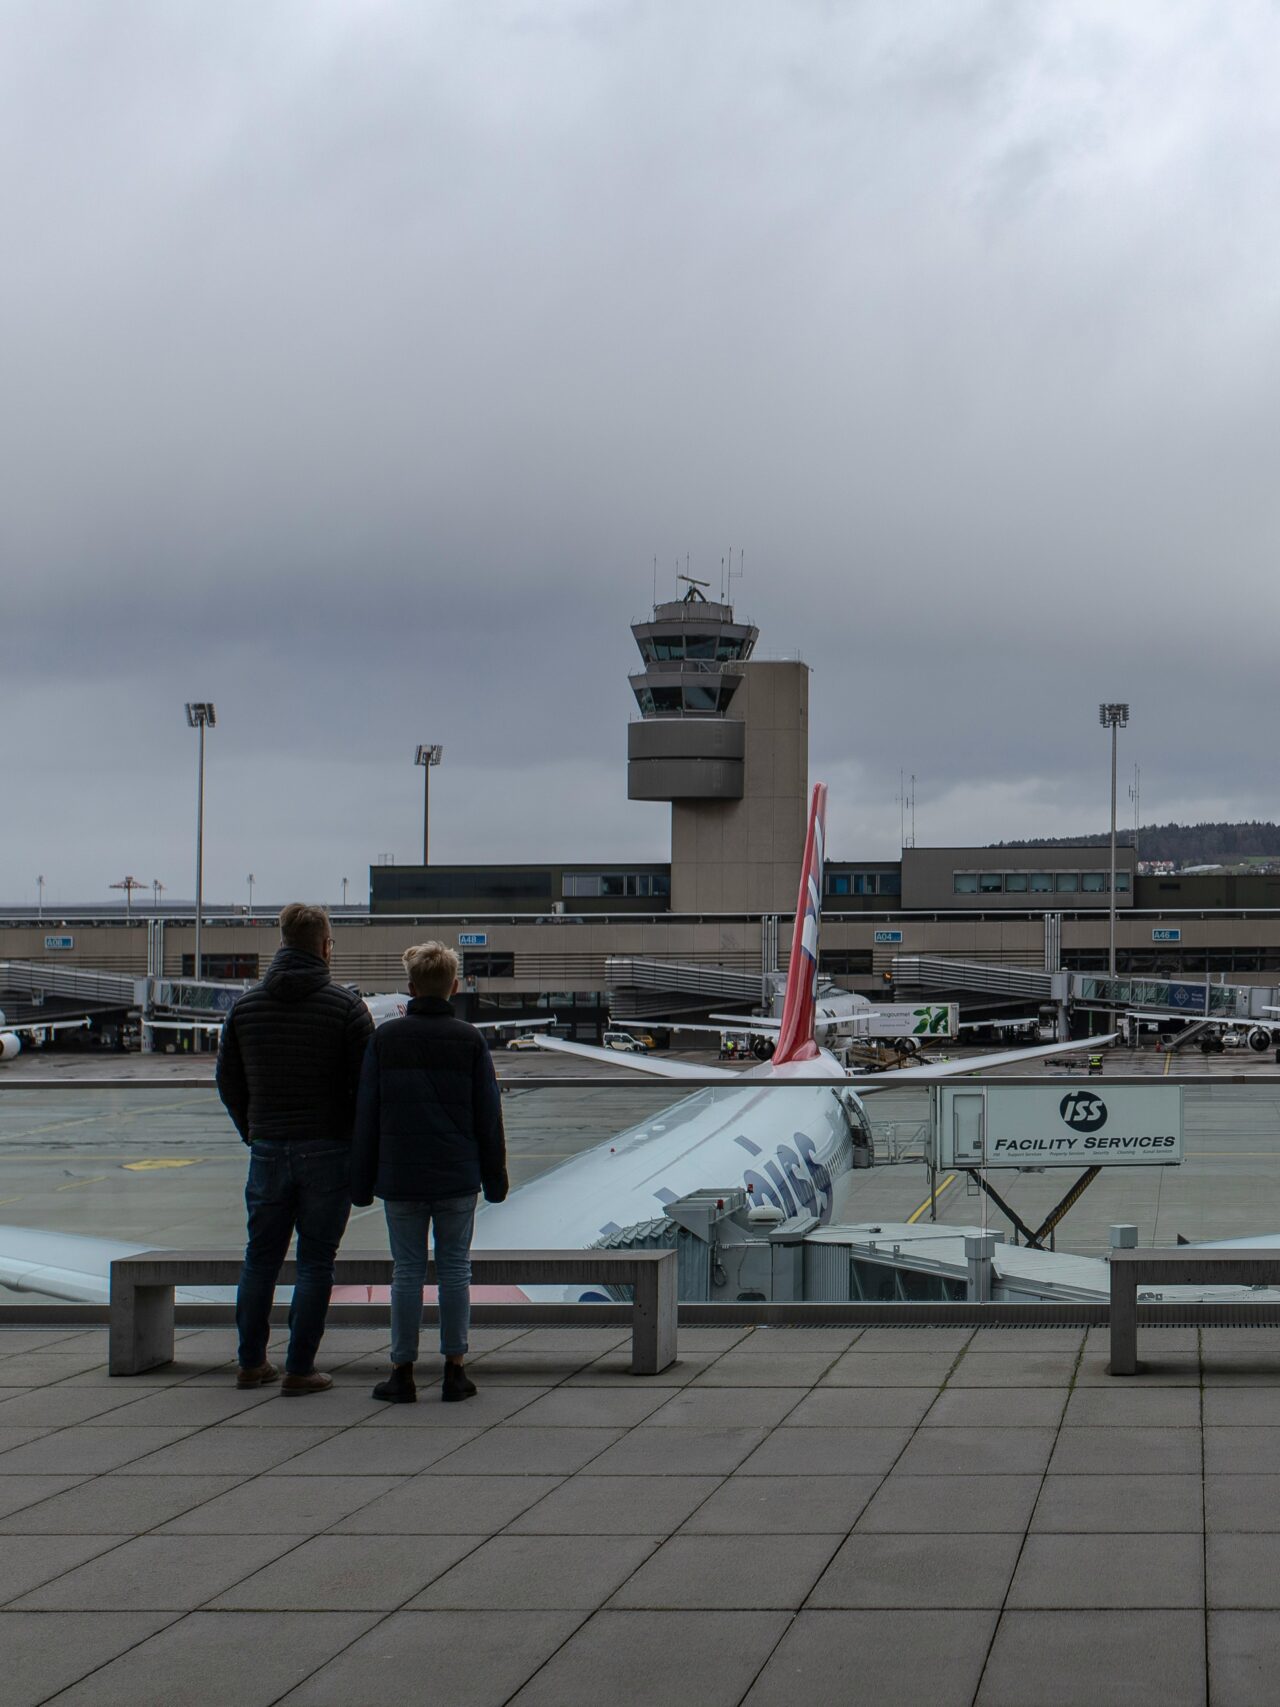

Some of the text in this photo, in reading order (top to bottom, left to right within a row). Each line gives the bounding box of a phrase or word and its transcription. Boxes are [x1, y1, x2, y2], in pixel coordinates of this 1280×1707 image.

[876, 933, 893, 941] A04
[1154, 931, 1170, 939] A46
[1063, 1090, 1104, 1122] ISS
[994, 1136, 1176, 1151] FACILITY SERVICES
